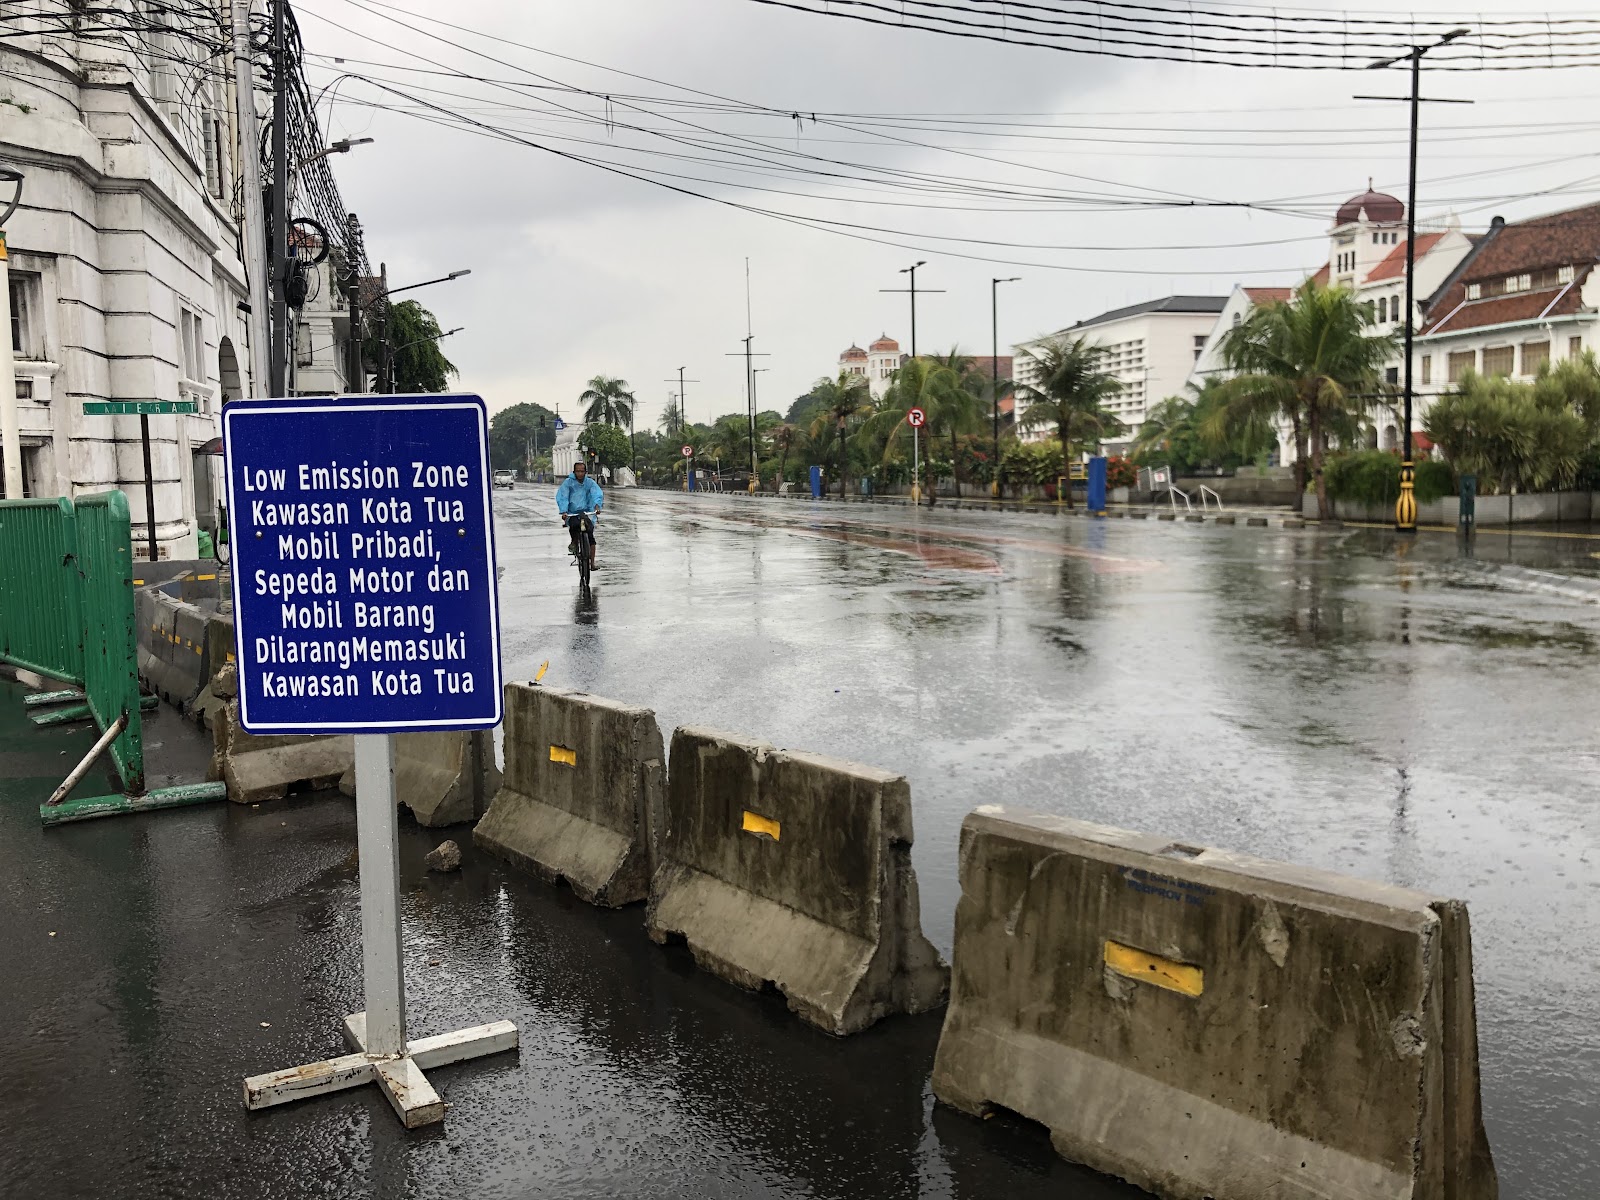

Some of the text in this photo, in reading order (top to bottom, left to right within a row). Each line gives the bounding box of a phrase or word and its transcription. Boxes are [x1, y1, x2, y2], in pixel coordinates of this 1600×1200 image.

[243, 460, 469, 492] Low Emission Zone
[251, 496, 465, 526] Kawasan Kota Tua
[278, 529, 441, 562] Mobil Pribadi,
[254, 564, 470, 602] Sepeda Motor dan
[281, 600, 435, 634] Mobil Barang
[262, 668, 475, 698] Kawasan Kota Tua
